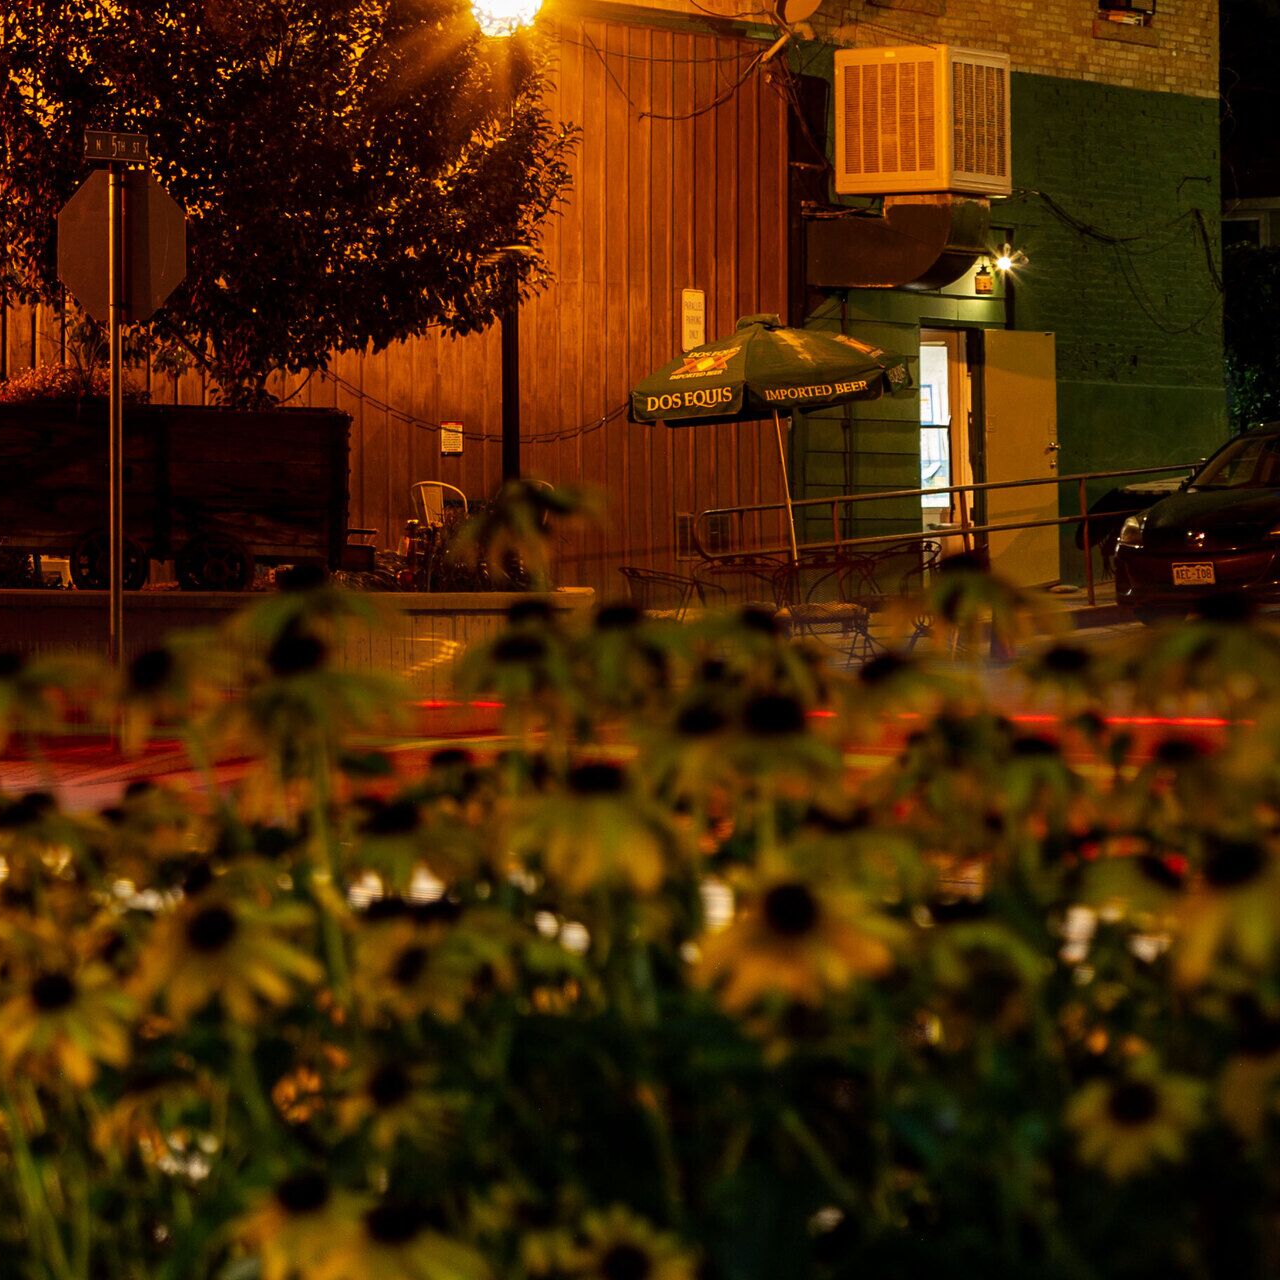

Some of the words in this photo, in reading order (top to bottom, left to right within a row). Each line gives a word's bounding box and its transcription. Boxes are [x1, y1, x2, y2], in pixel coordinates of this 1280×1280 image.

[111, 135, 127, 158] 5TH
[132, 140, 141, 154] ST
[687, 351, 713, 359] DOS
[669, 370, 706, 381] IMPORTED
[705, 369, 724, 377] BEER
[646, 392, 683, 413] DOS
[683, 386, 734, 409] EQUIS
[764, 384, 833, 402] IMPORTED
[834, 379, 869, 395] BEER
